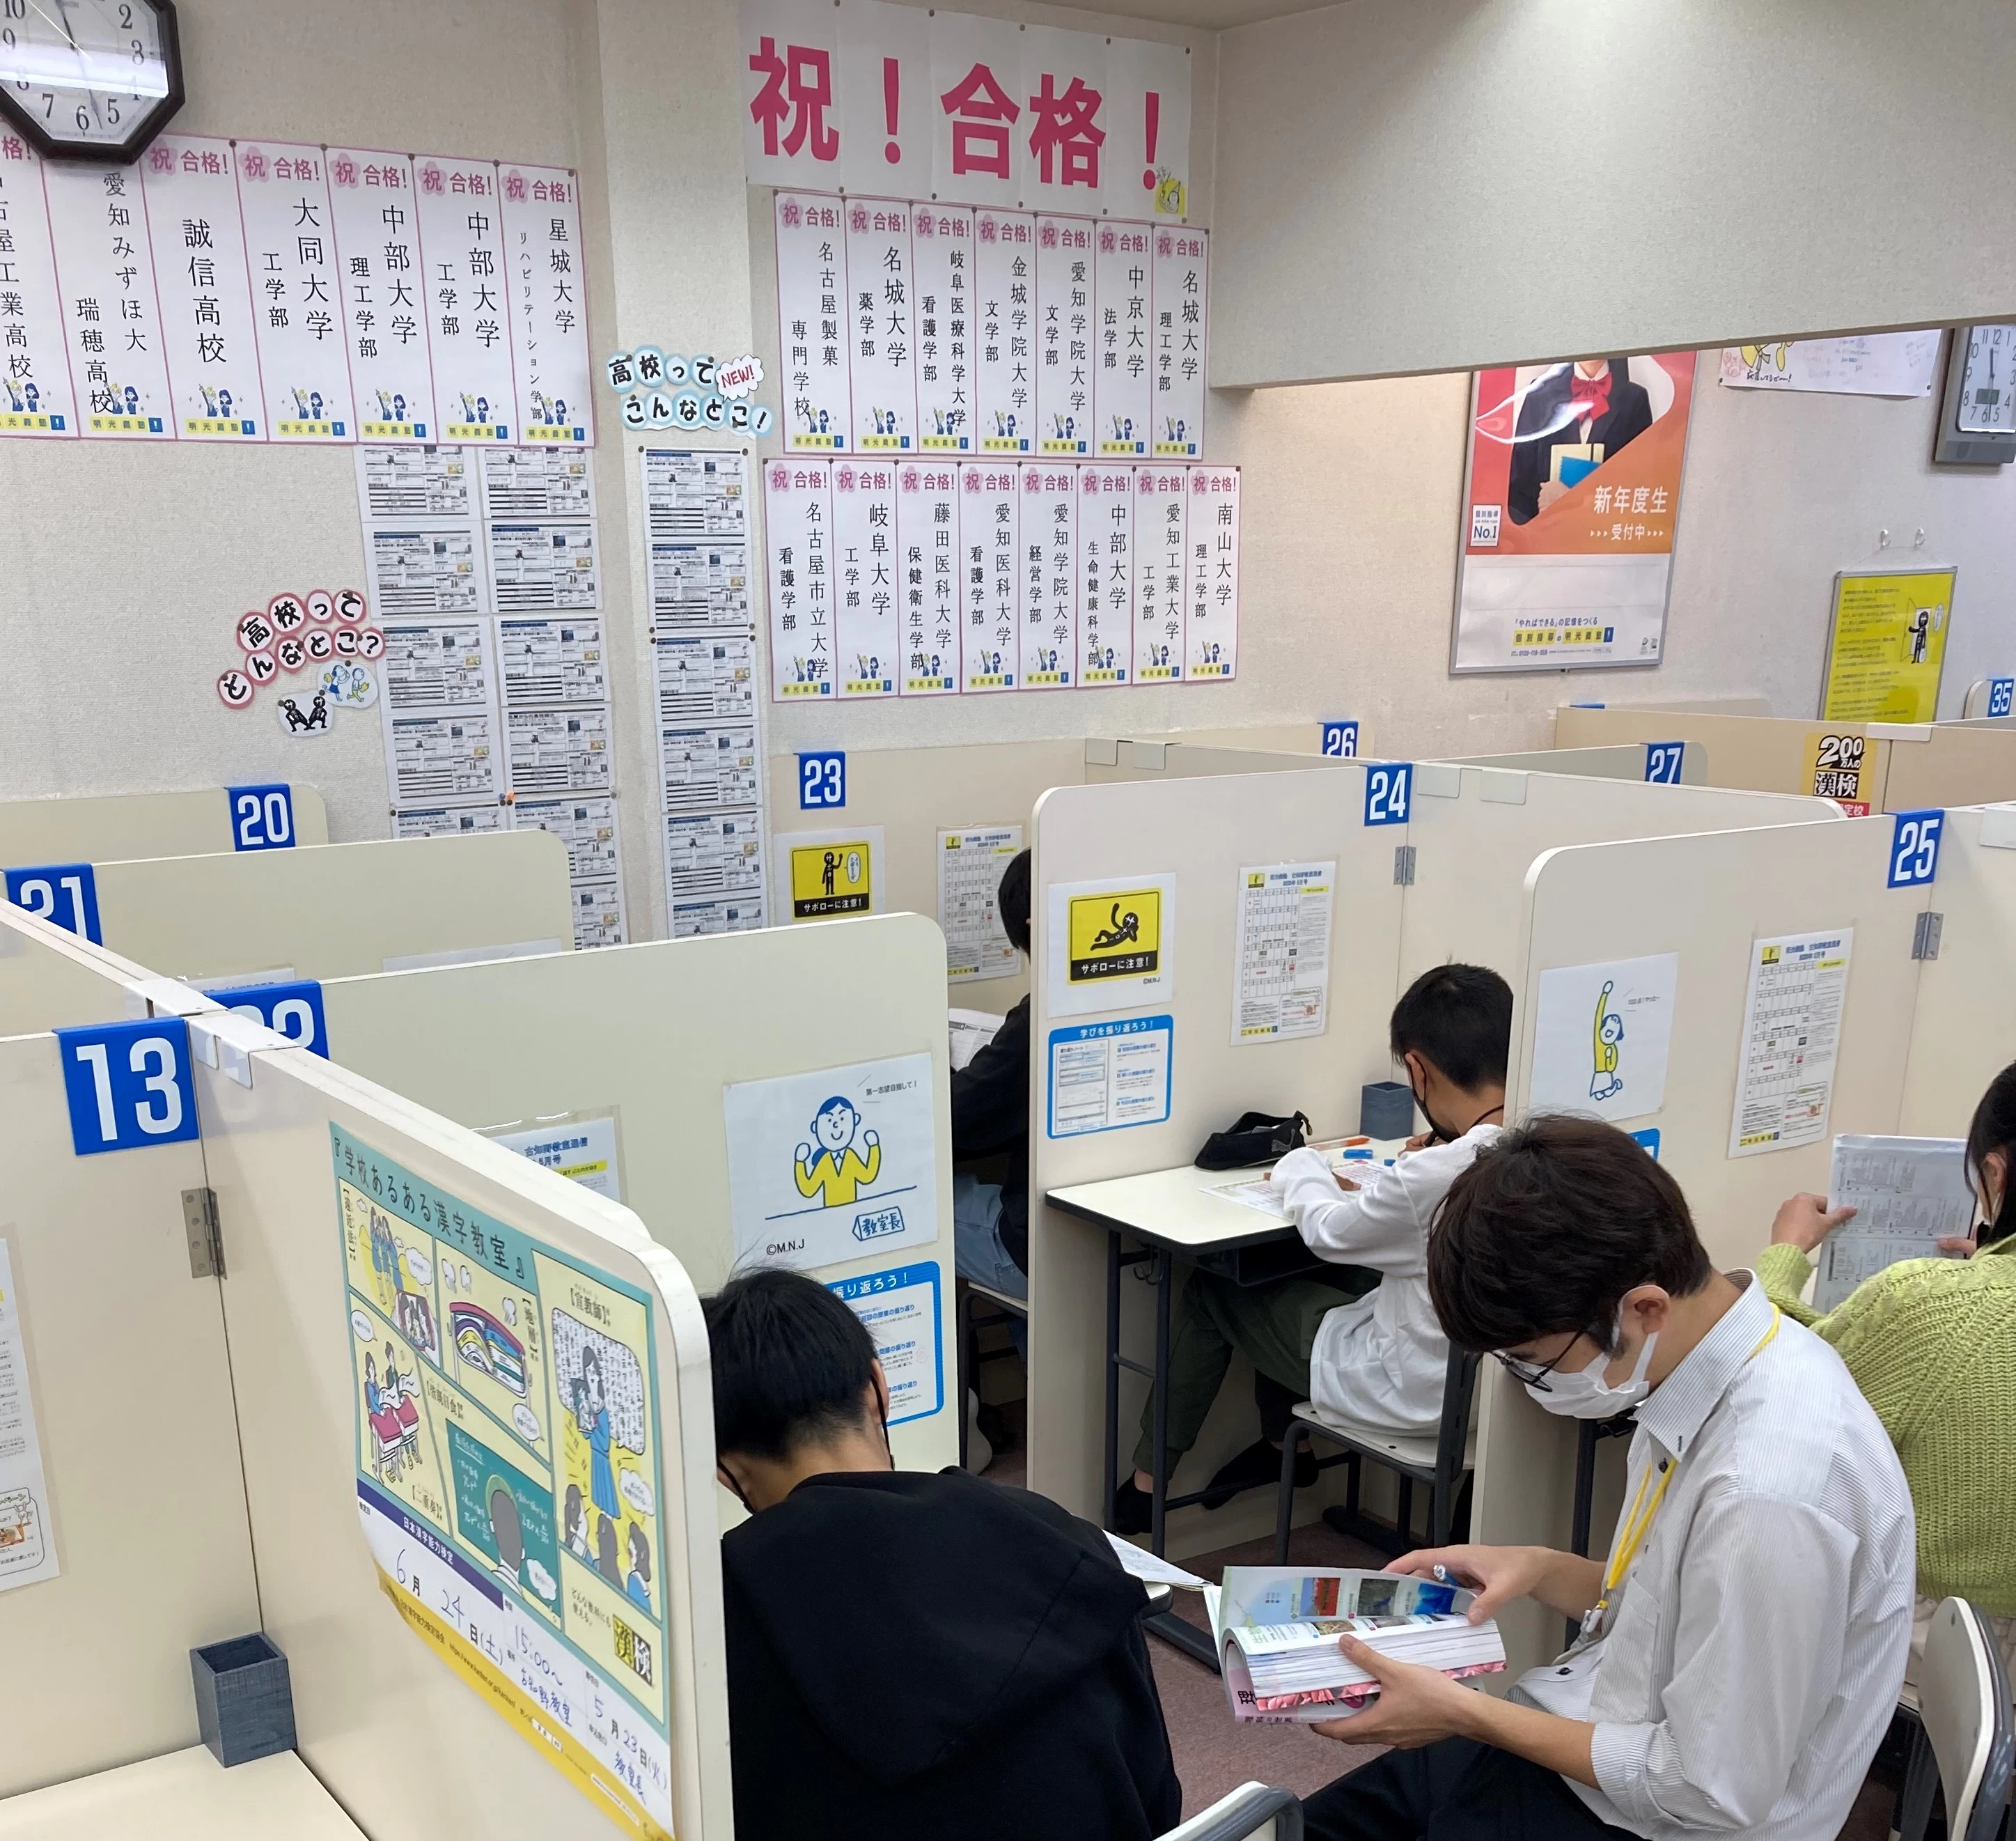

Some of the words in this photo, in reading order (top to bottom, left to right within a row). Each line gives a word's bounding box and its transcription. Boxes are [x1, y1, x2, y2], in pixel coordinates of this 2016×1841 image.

[118, 4, 133, 29] 2
[2, 28, 16, 51] 9
[131, 40, 145, 65] 3
[42, 93, 54, 118] 7
[76, 106, 89, 130] 6
[107, 98, 120, 124] 5
[151, 148, 172, 171] 祝
[180, 150, 229, 175] 合格!
[245, 155, 265, 177] 祝
[274, 157, 320, 181] 合格!
[336, 162, 355, 184] 祝
[363, 164, 407, 188] 合格!
[423, 169, 442, 192] 祝
[450, 172, 492, 196] 合格!
[506, 177, 525, 199] 祝
[532, 180, 572, 203] 合格!
[783, 205, 799, 224] 祝
[805, 207, 839, 228] 合格!
[852, 211, 867, 230] 祝
[873, 212, 905, 232] 合格!
[918, 216, 932, 234] 祝
[938, 217, 969, 237] 合格!
[981, 221, 994, 240] 祝
[1001, 223, 1031, 242] 合格!
[1042, 226, 1055, 245] 祝
[1061, 228, 1090, 248] 合格!
[104, 172, 147, 351] 愛知みずほ大
[1102, 231, 1114, 250] 祝
[1120, 233, 1148, 253] 合格!
[1158, 237, 1171, 254] 祝
[1177, 239, 1203, 257] 合格!
[294, 198, 333, 341] 大同大学
[382, 204, 416, 345] 中部大学
[468, 211, 499, 348] 中部大学
[549, 218, 575, 334] 星城大学
[182, 219, 227, 364] 誠信高校
[263, 253, 289, 328] 工学部
[350, 257, 377, 358] 理工学部
[437, 263, 460, 336] 工学部
[818, 241, 838, 366] 名古屋製菓
[883, 247, 906, 367] 名城大学
[859, 293, 875, 358] 薬学部
[922, 296, 937, 382] 看護学部
[951, 250, 966, 427] 岐阜医療科学大学
[985, 300, 999, 362] 文学部
[1011, 256, 1027, 408] 金城学院大学
[1045, 305, 1058, 366] 文学部
[1070, 261, 1086, 411] 愛知学院大学
[1104, 308, 1117, 368] 法学部
[1127, 265, 1144, 378] 中京大学
[1181, 270, 1198, 380] 名城大学
[1983, 329, 1988, 344] 11
[1993, 329, 2001, 344] 12
[76, 299, 114, 414] 瑞穂高校
[609, 354, 713, 384] 高校って
[791, 320, 810, 416] 専門学校
[1159, 312, 1172, 391] 理工学部
[721, 364, 755, 388] NEW!
[1967, 366, 1972, 382] 9
[1963, 391, 1969, 406] 8
[1970, 406, 1977, 420] 7
[1982, 406, 1987, 422] 6
[1993, 407, 2000, 422] 5
[2004, 394, 2010, 409] 4
[772, 471, 788, 488] 祝
[794, 471, 827, 488] 合格!
[839, 472, 853, 488] 祝
[860, 472, 891, 489] 合格!
[904, 472, 918, 489] 祝
[923, 473, 954, 490] 合格!
[966, 474, 979, 490] 祝
[985, 474, 1015, 491] 合格!
[1026, 474, 1038, 490] 祝
[1045, 475, 1072, 491] 合格!
[1084, 475, 1097, 491] 祝
[1102, 476, 1130, 492] 合格!
[1141, 476, 1152, 491] 祝
[1158, 477, 1184, 492] 合格!
[1194, 476, 1205, 491] 祝
[1211, 476, 1235, 492] 合格!
[1594, 486, 1668, 514] 新年度生
[1611, 524, 1645, 541] 受付中
[870, 503, 891, 616] 岐阜大学
[995, 503, 1010, 646] 愛知医科大学
[1054, 504, 1068, 644] 愛知学院大学
[1110, 504, 1126, 609] 中部大学
[1166, 504, 1180, 639] 愛知工業大学
[1217, 503, 1233, 605] 南山大学
[779, 547, 796, 631] 看護学部
[806, 502, 828, 678] 名古屋市立大学
[845, 548, 860, 607] 工学部
[934, 502, 951, 648] 藤田医科大学
[970, 546, 984, 626] 看護学部
[1029, 545, 1042, 623] 経営学部
[1143, 566, 1155, 620] 工学部
[1195, 545, 1208, 618] 理工学部
[242, 593, 361, 648] 高校って
[908, 546, 923, 670] 保健衛生学部
[1088, 541, 1098, 665] 生命健康科学部
[1992, 682, 2013, 713] 35
[1327, 727, 1355, 757] 26
[1817, 736, 1864, 767] 200
[804, 759, 841, 804] 23
[1649, 747, 1681, 784] 27
[1815, 771, 1858, 798] 漢検
[1369, 770, 1406, 821] 24
[237, 793, 290, 846] 20
[1894, 818, 1939, 881] 25
[77, 1037, 182, 1141] 13
[861, 1211, 900, 1237] 教室長
[412, 1575, 420, 1597] 月
[594, 1695, 604, 1718] 5
